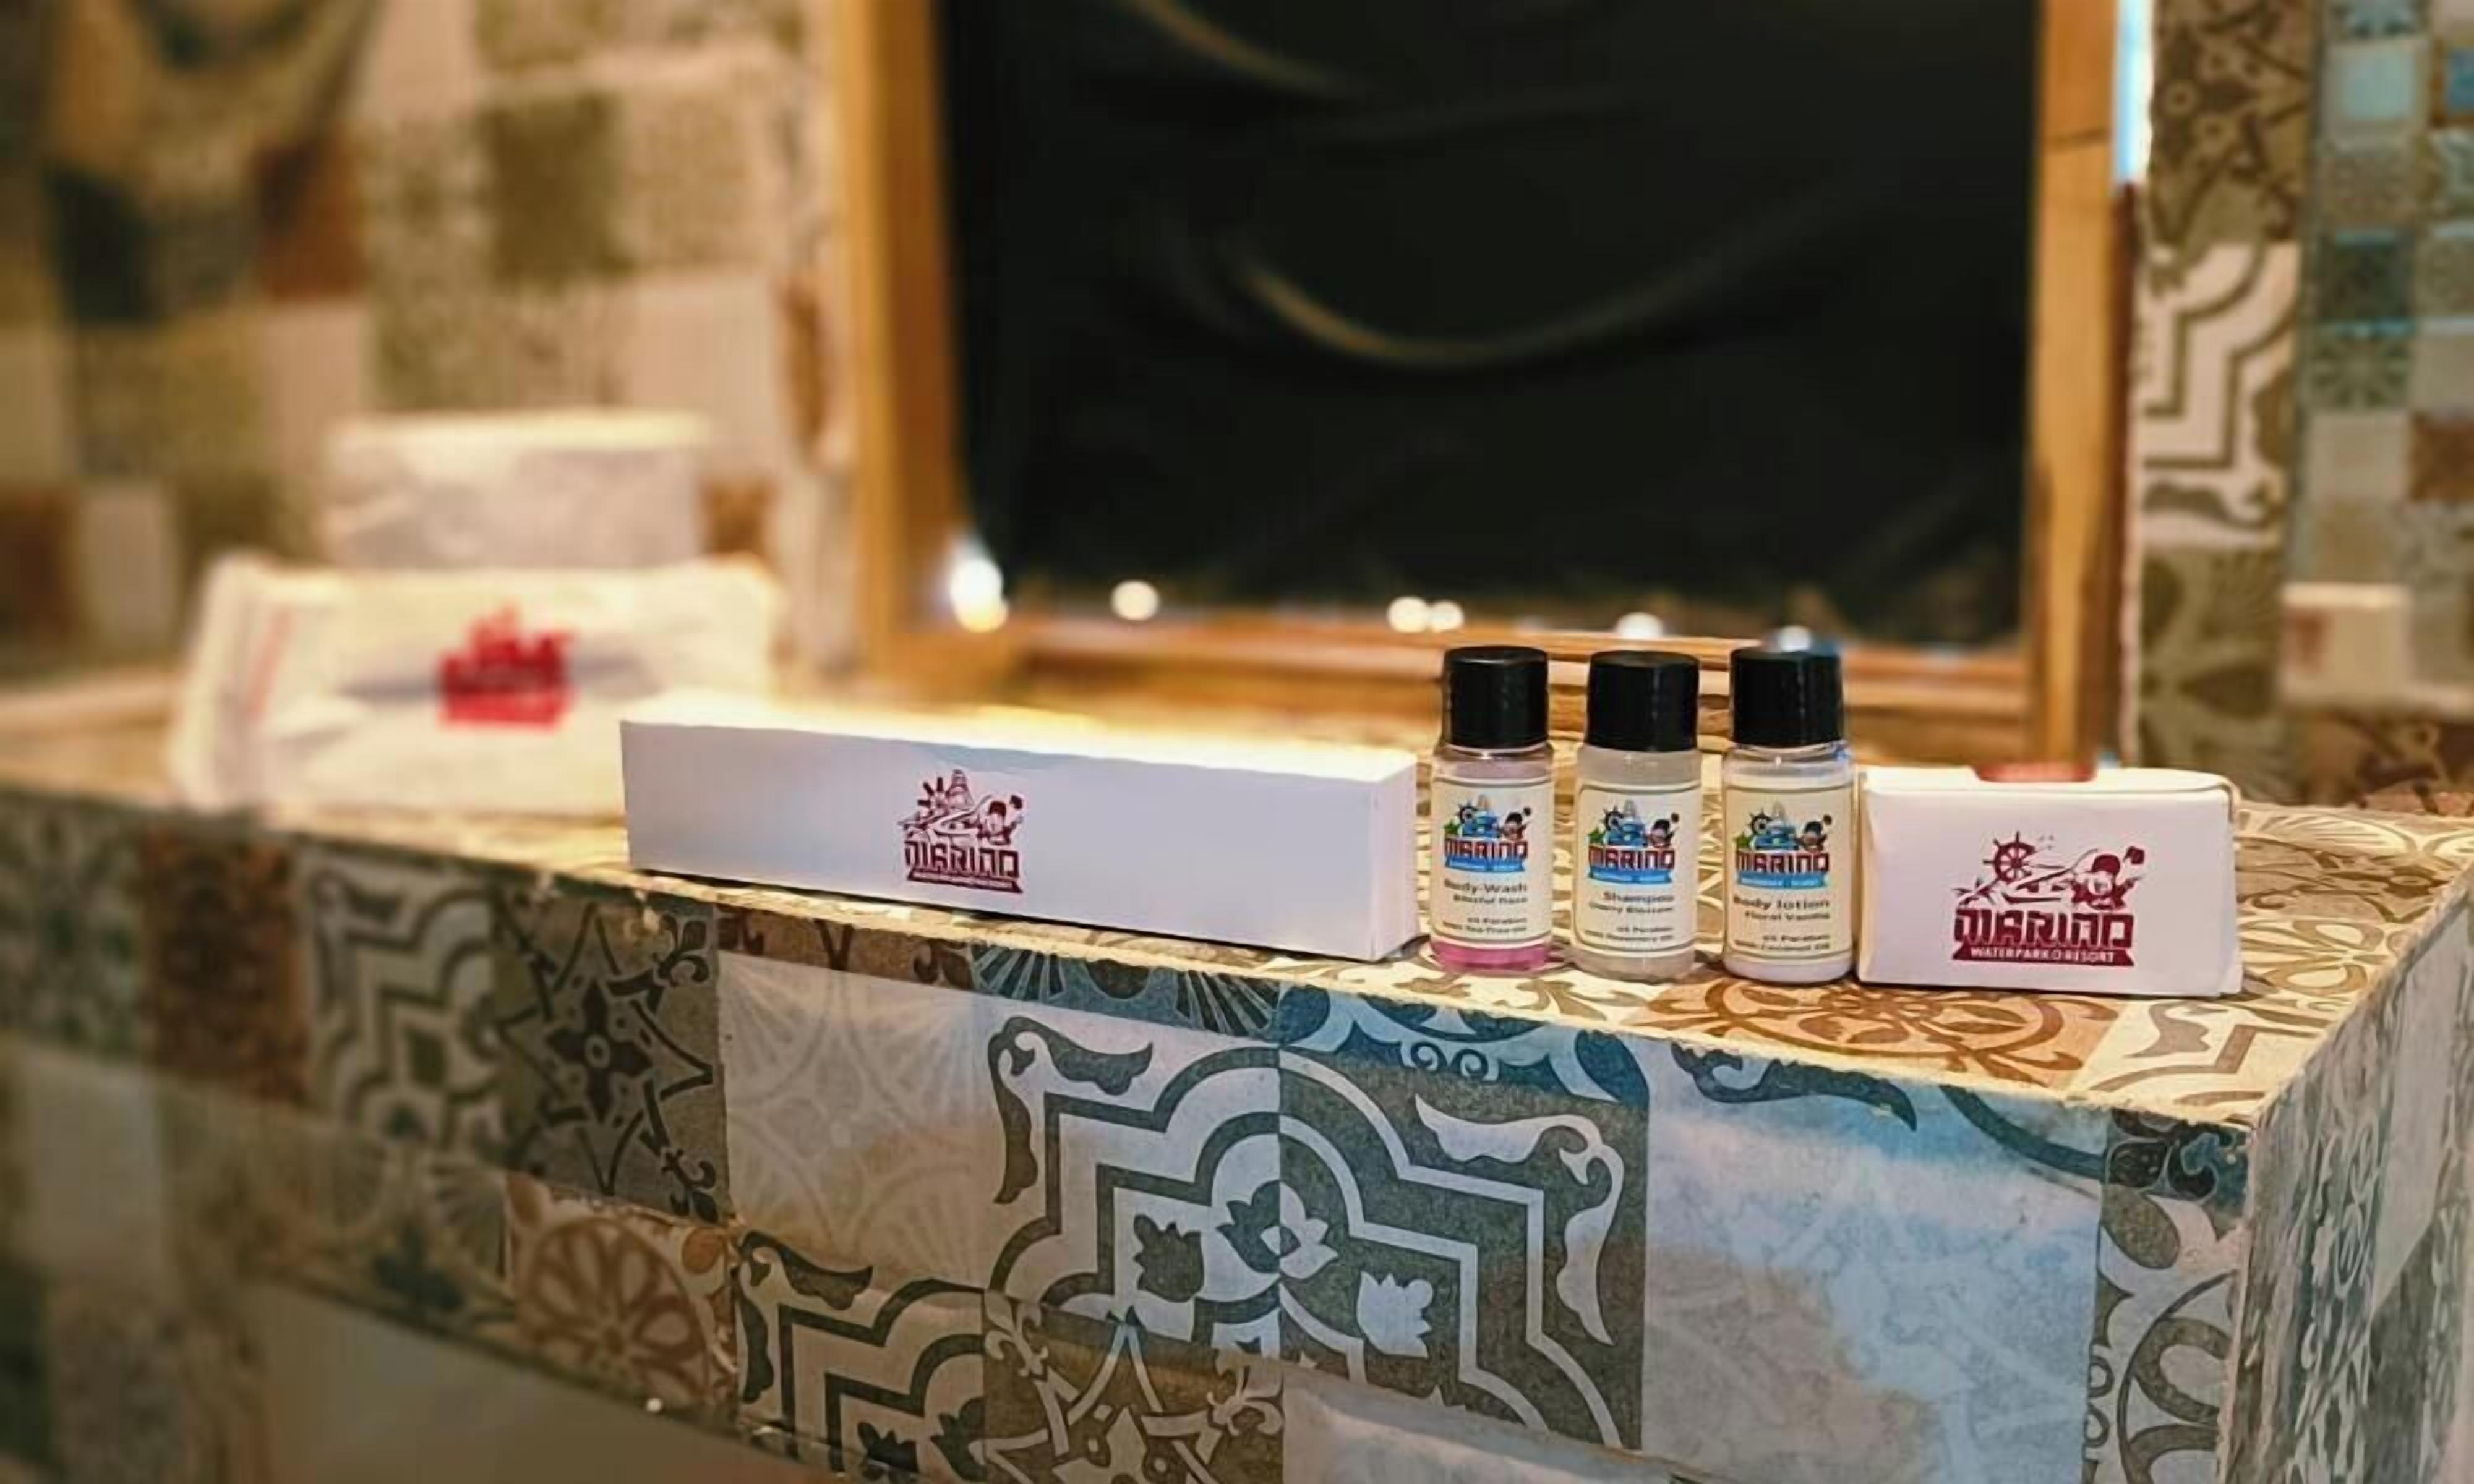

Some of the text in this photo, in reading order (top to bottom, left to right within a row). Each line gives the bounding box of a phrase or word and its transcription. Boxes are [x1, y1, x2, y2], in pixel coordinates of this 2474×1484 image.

[904, 840, 1019, 879] MARINO
[1736, 850, 1830, 874] MARINO
[1954, 908, 2134, 949] MARINO
